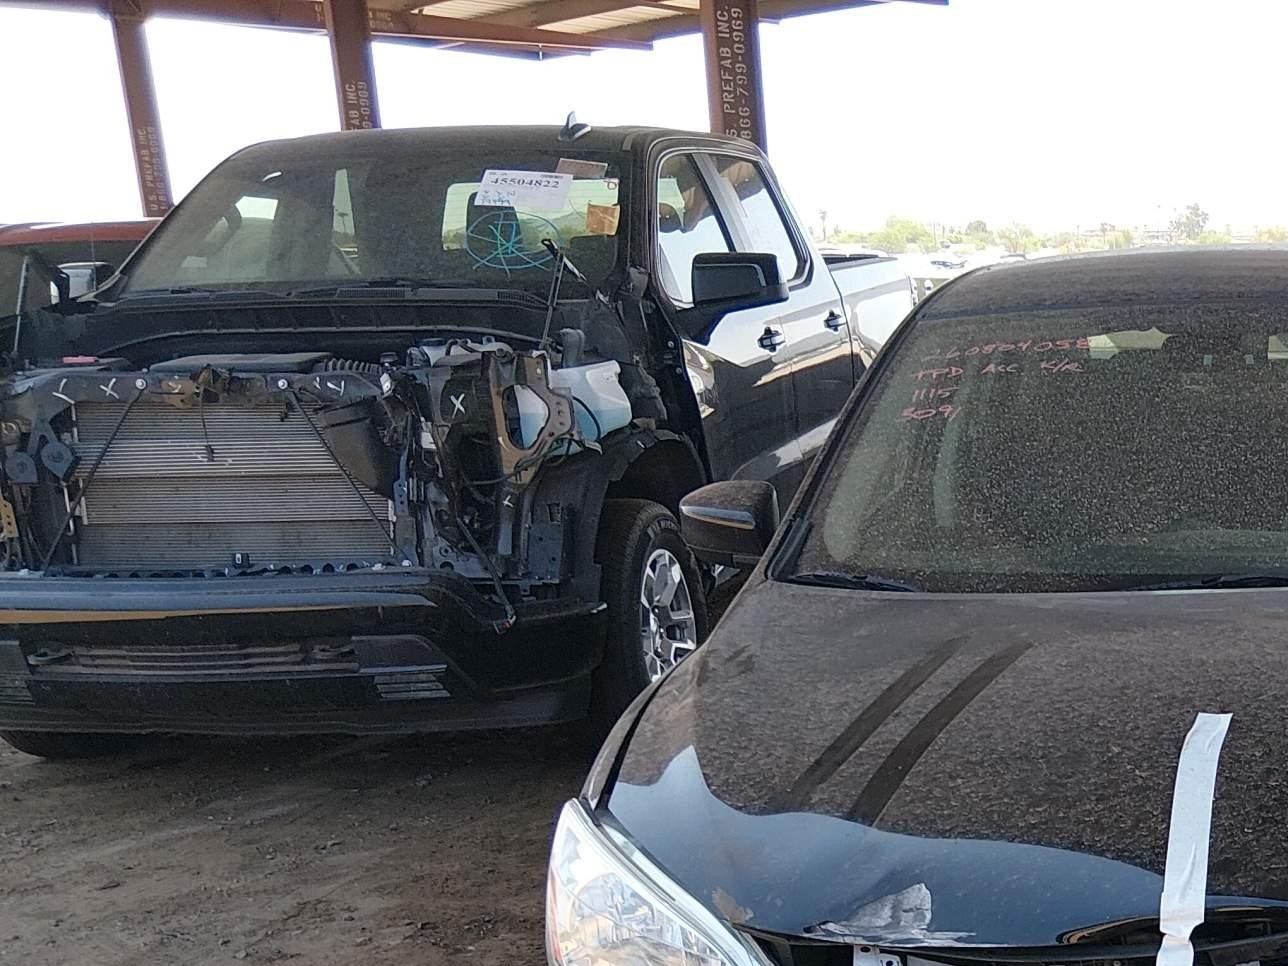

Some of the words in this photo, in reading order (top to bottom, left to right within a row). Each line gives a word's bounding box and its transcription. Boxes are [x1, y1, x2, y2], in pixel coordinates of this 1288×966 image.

[716, 5, 730, 38] INC.
[719, 47, 736, 114] PREFAB
[731, 7, 752, 140] 866-799-0969
[490, 176, 560, 189] 45504822
